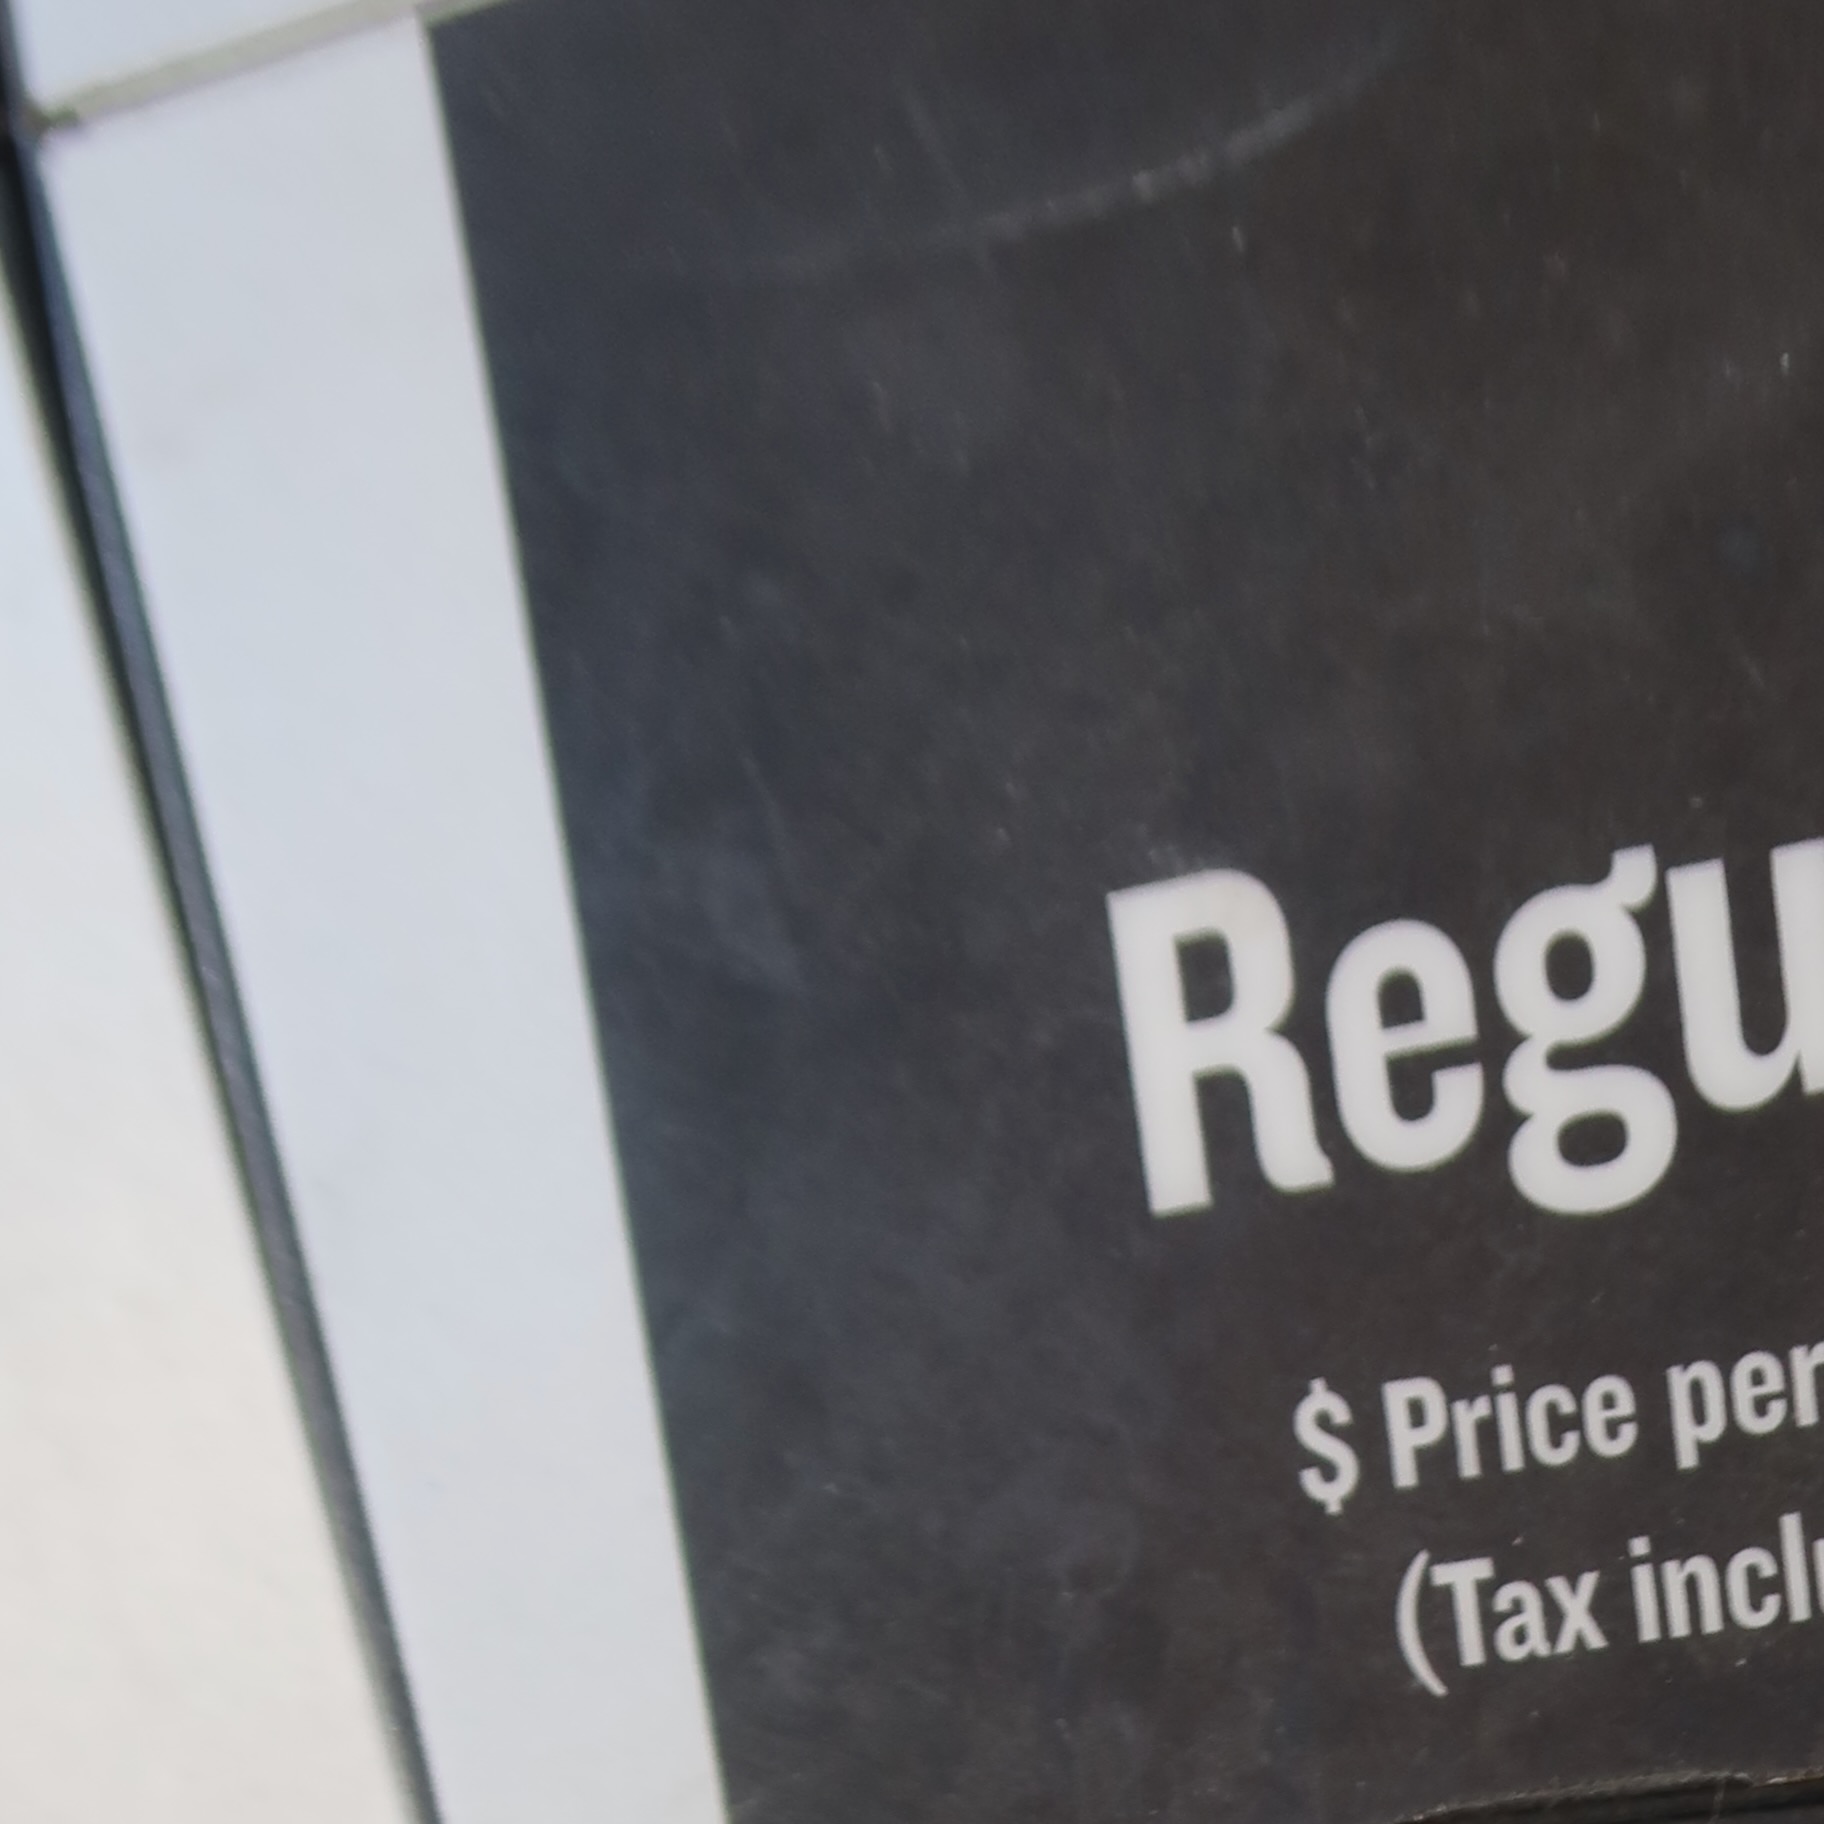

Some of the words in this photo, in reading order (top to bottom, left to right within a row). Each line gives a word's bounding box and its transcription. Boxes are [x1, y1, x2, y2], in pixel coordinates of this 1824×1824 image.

[1293, 1379, 1359, 1514] $
[1383, 1366, 1638, 1490] Price
[1396, 1549, 1607, 1697] (Tax
